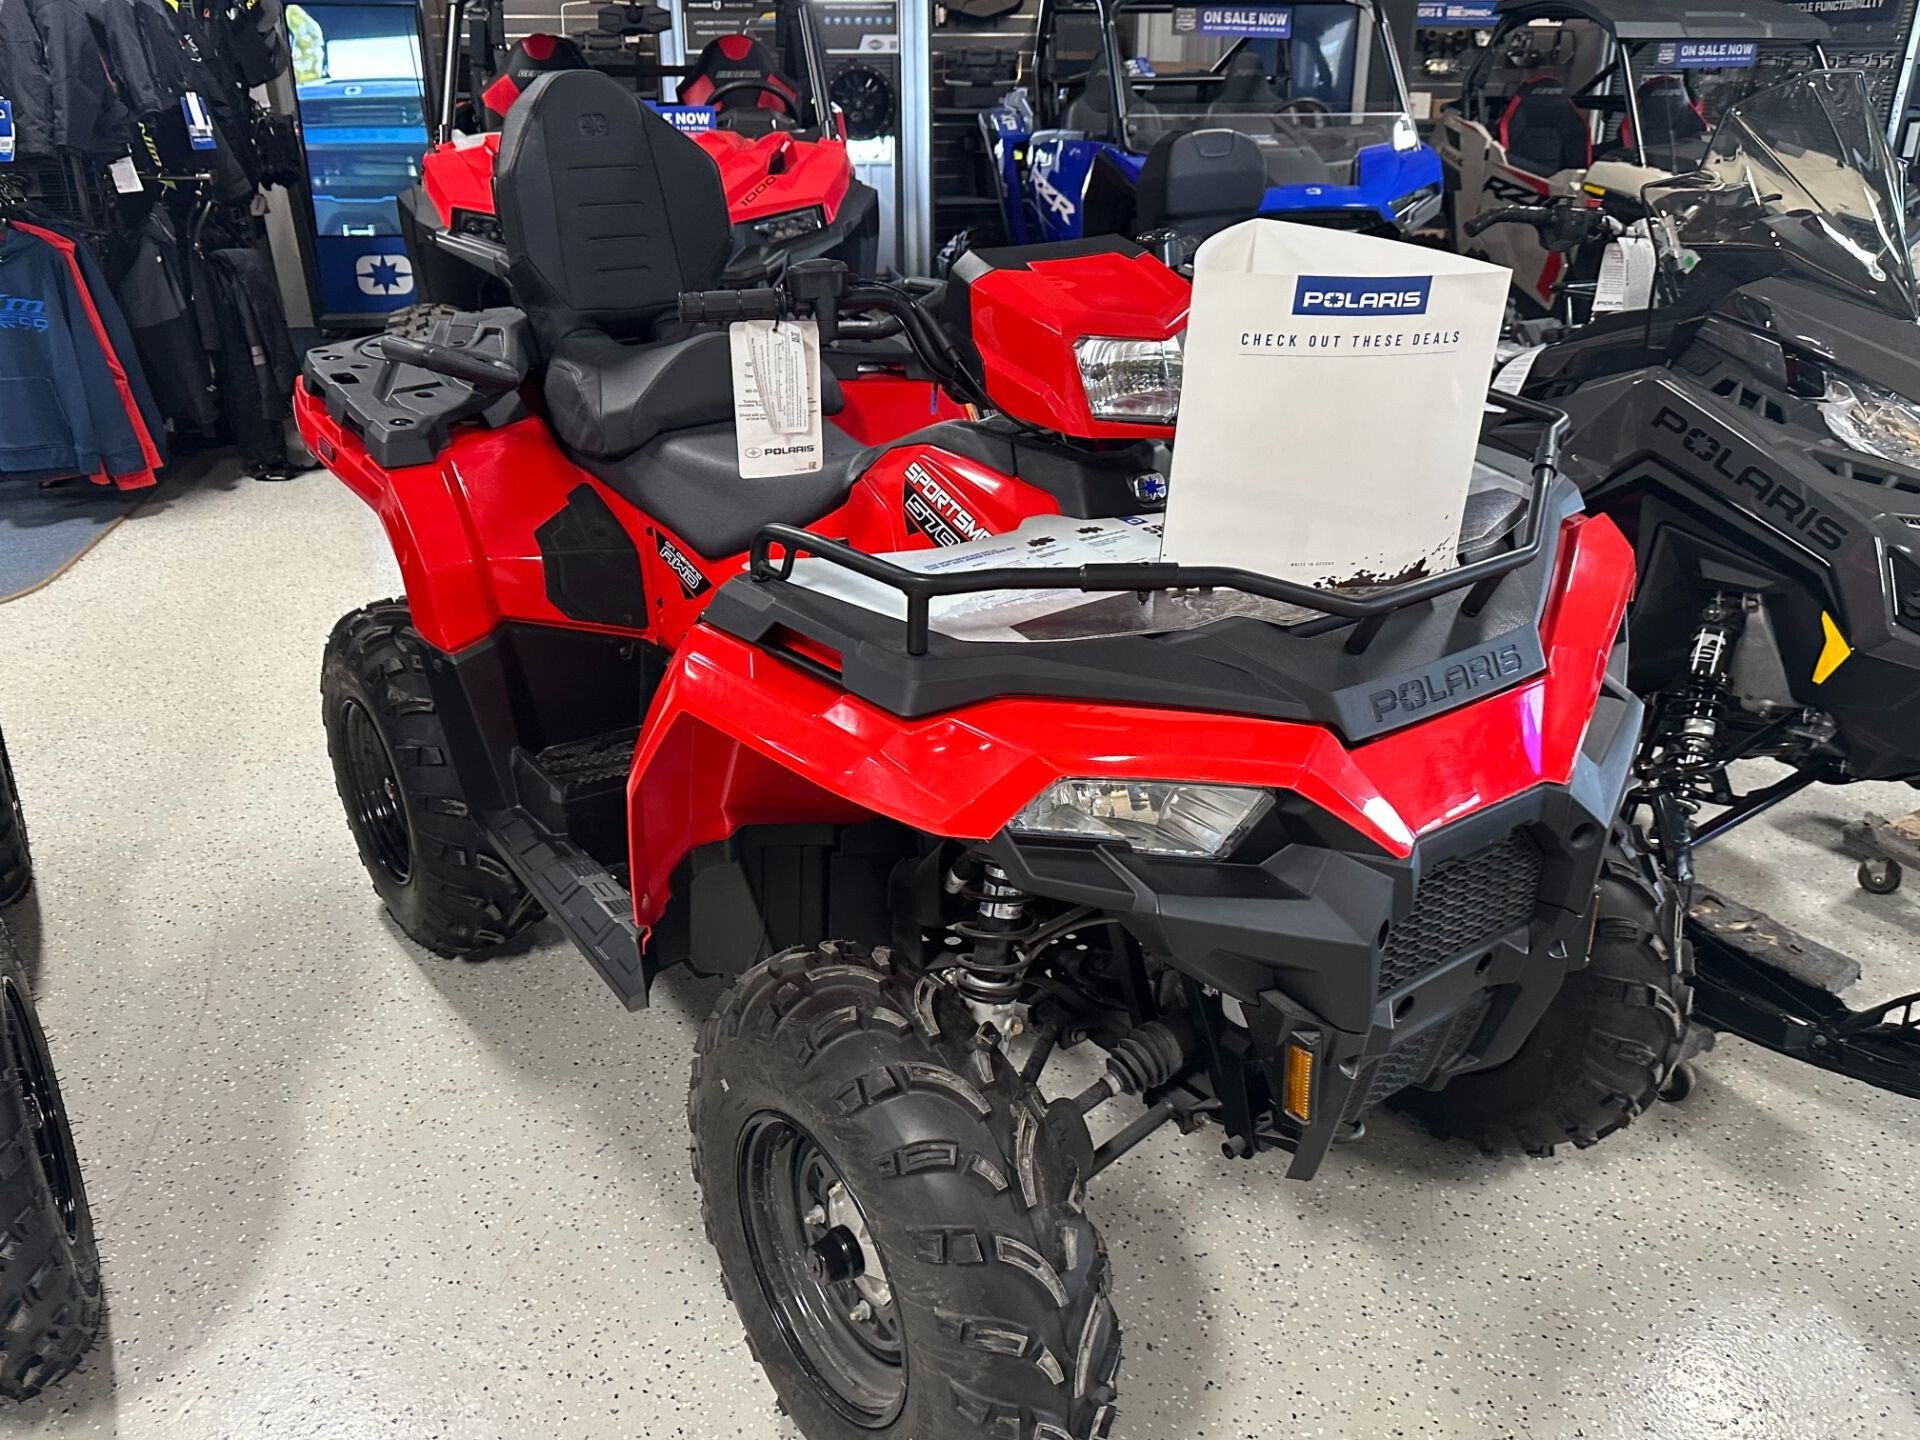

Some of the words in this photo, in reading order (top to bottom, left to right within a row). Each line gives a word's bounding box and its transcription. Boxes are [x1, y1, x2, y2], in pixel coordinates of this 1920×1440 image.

[1203, 11, 1222, 24] ON
[1223, 12, 1257, 25] SALE
[1258, 13, 1288, 26] NOW
[1681, 45, 1697, 56] ON
[1698, 44, 1727, 56] SALE
[1727, 44, 1754, 55] NOW
[675, 112, 710, 125] NOW
[741, 176, 777, 206] 1000
[1030, 162, 1075, 226] RZR
[1302, 291, 1421, 309] POLARIS
[1241, 333, 1298, 347] CHECK
[1308, 335, 1341, 348] OUT
[1352, 335, 1404, 348] THESE
[1412, 330, 1461, 346] DEALS
[764, 445, 815, 456] POLARIS
[1651, 406, 1848, 551] POLARIS
[660, 546, 700, 589] AWD
[1369, 644, 1522, 722] POLARIS
